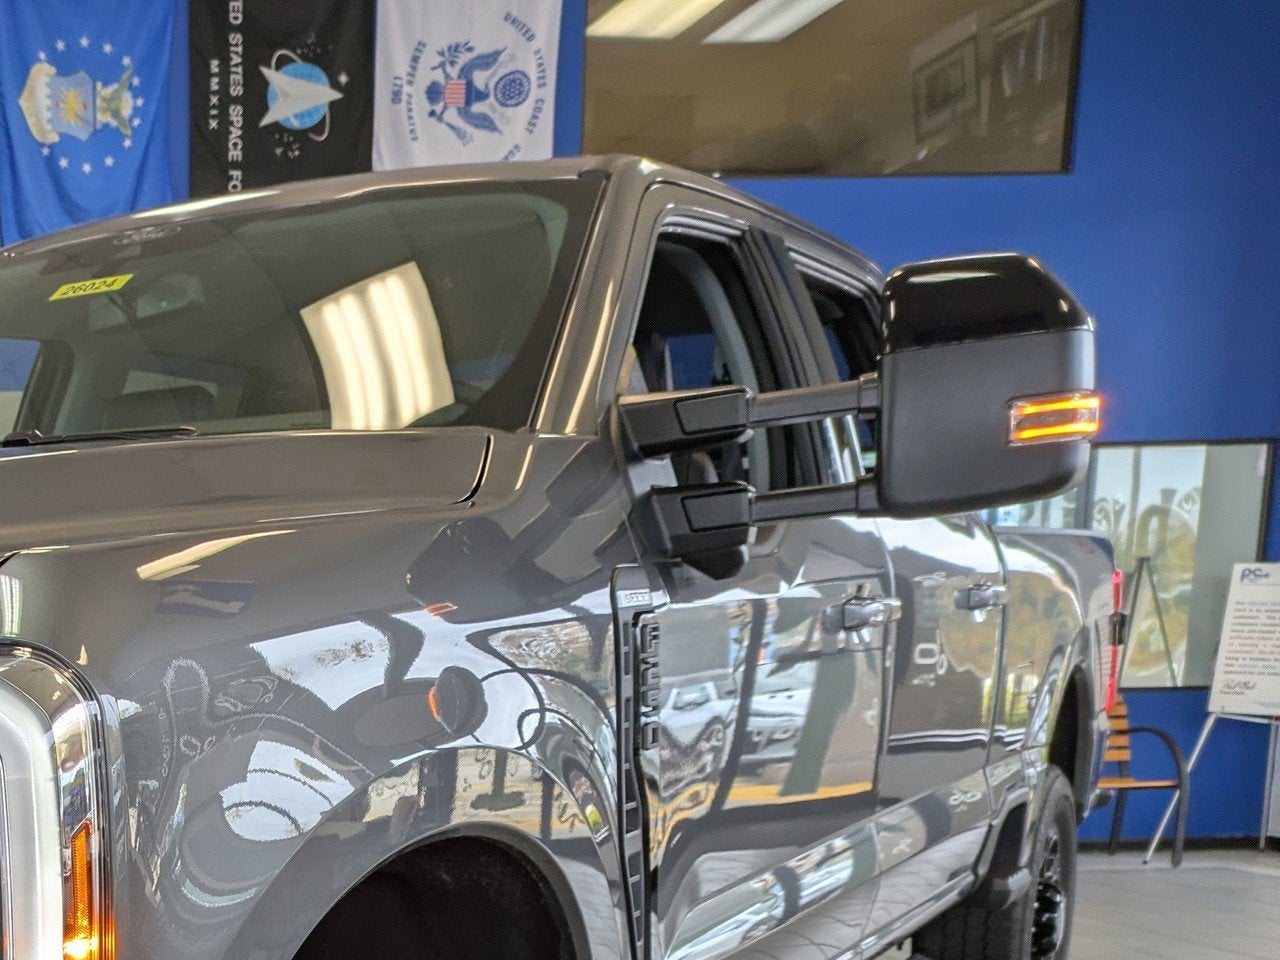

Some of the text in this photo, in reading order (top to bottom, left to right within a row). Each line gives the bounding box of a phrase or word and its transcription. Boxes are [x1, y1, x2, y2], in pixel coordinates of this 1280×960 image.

[503, 12, 537, 43] UNITED
[533, 48, 548, 90] STATES
[228, 0, 243, 192] ED STATES SPACE FO
[525, 98, 546, 135] COAST
[60, 278, 119, 296] 26024
